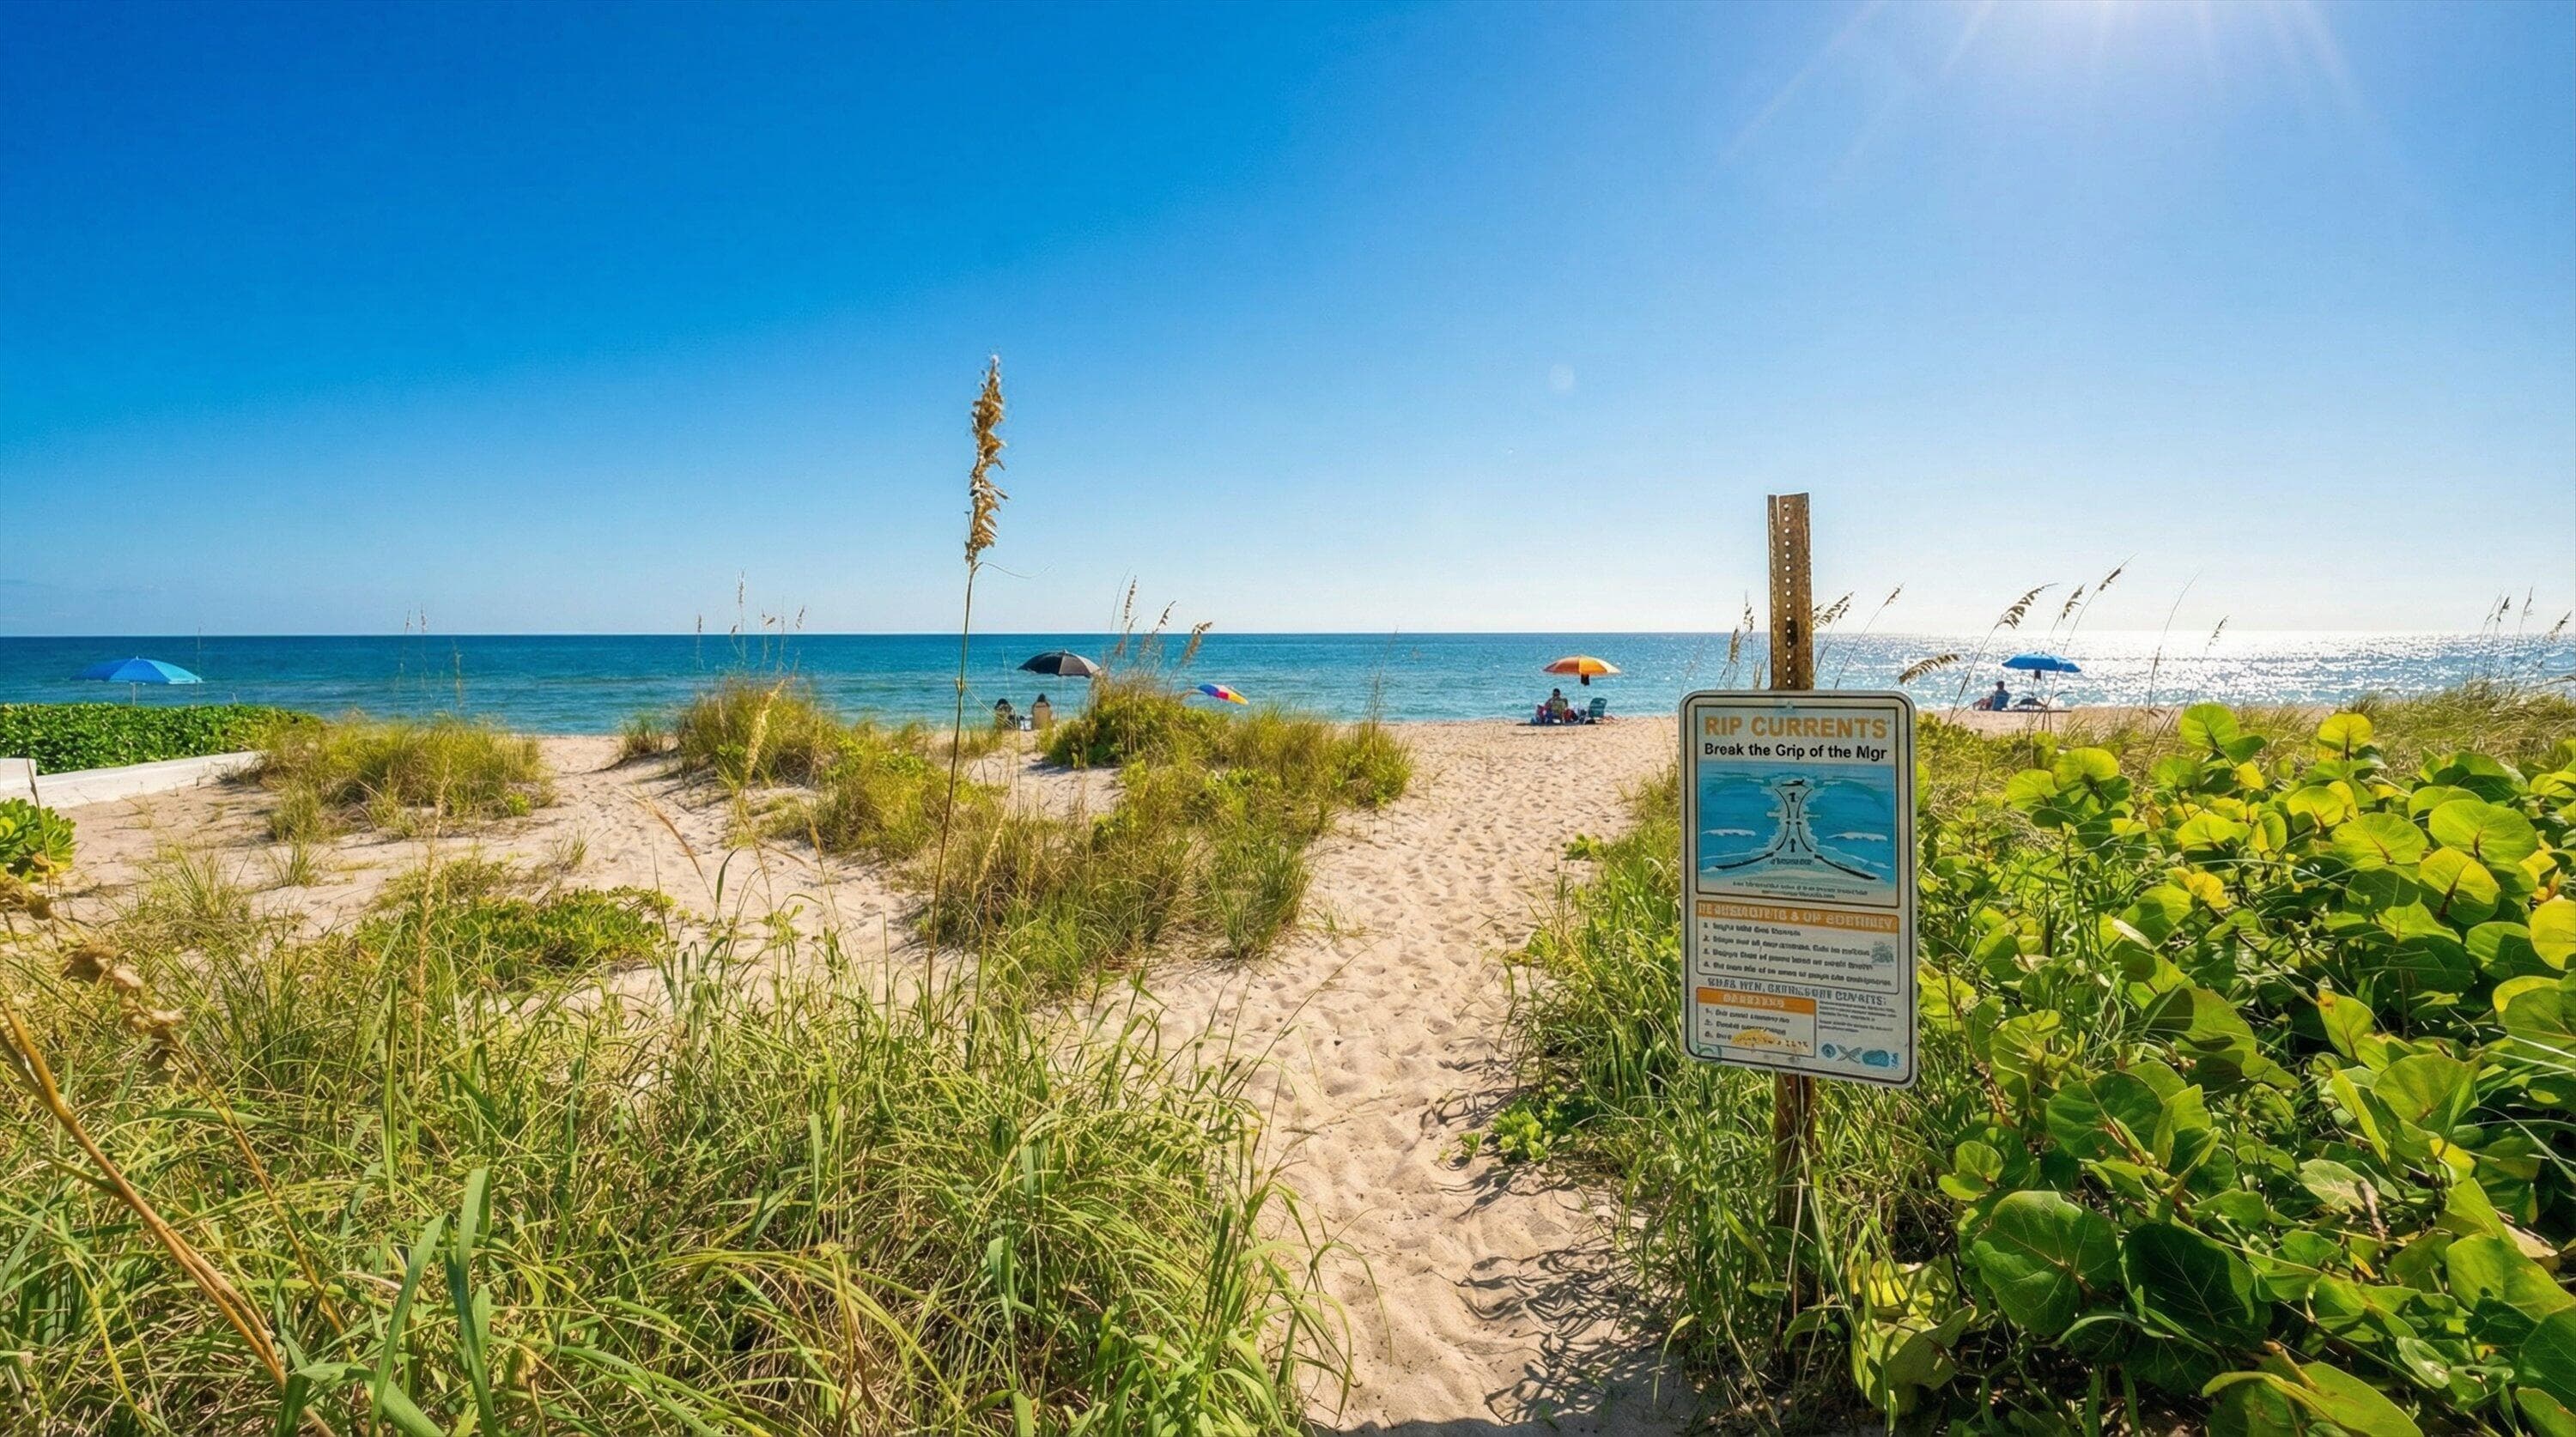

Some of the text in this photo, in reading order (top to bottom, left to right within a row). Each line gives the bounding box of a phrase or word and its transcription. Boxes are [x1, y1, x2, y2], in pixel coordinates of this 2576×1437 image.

[1704, 716, 1888, 739] RIP CURRENTS
[1704, 743, 1887, 762] Break the Grip of the Mgr
